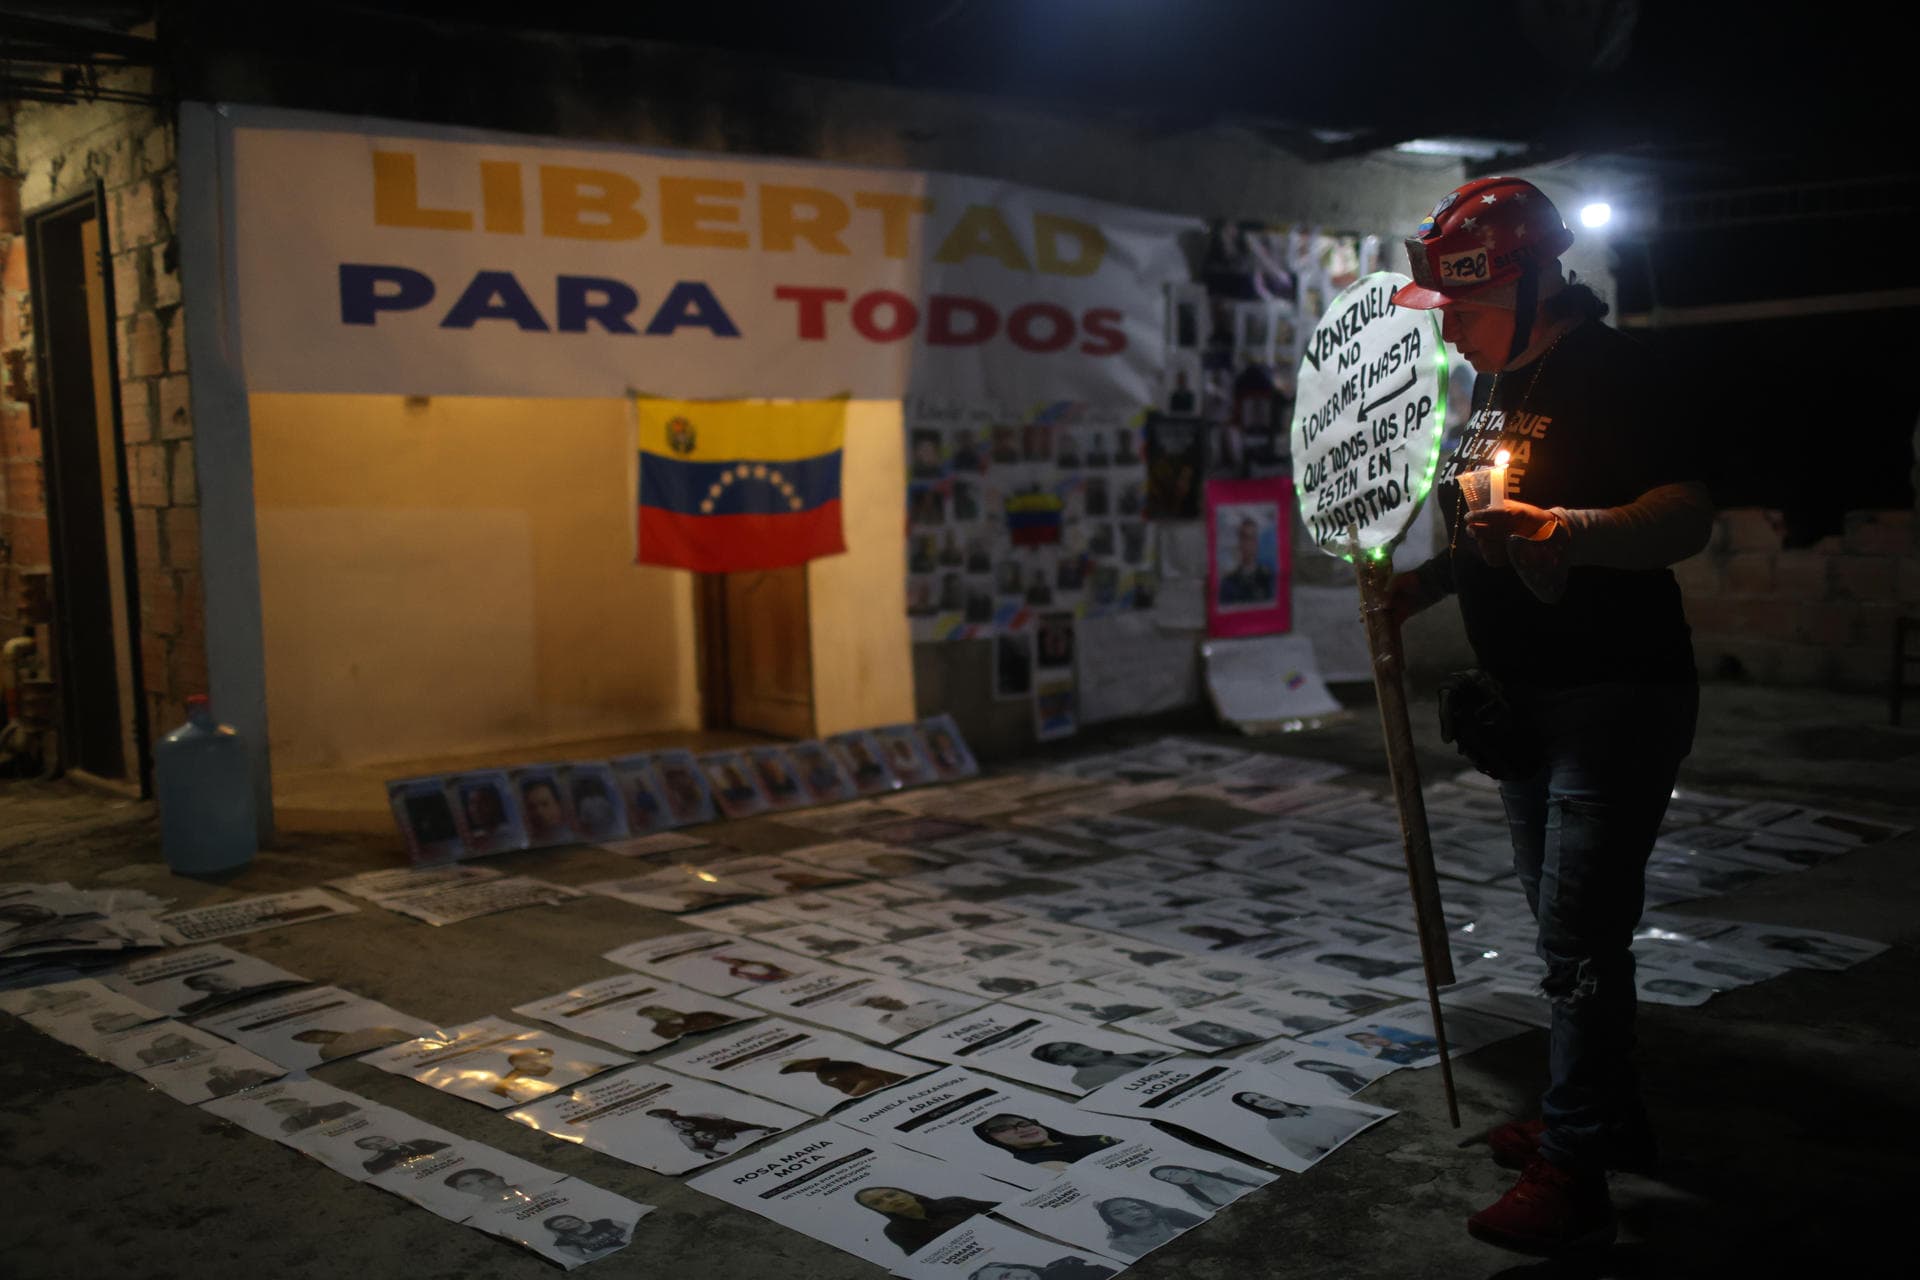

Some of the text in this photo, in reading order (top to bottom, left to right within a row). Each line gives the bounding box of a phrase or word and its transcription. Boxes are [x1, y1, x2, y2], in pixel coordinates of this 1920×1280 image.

[372, 151, 1108, 277] LIBERTAD
[339, 263, 1128, 356] PARA TODOS
[1306, 284, 1398, 372] VENEZUELA
[1337, 342, 1361, 374] NO
[1368, 327, 1421, 389] HASTA
[1465, 409, 1506, 432] ASTA
[1303, 463, 1327, 493] QUE
[1331, 430, 1368, 474] TODOS
[1372, 413, 1398, 448] LOS
[1317, 449, 1392, 512] ESTEN EN
[859, 1076, 967, 1124] DANIELA ALEXANDRA
[1141, 1073, 1191, 1095] ROJAS
[733, 1163, 781, 1185] ROSA
[780, 1140, 834, 1163] MARÍA
[774, 1154, 825, 1178] MOTA
